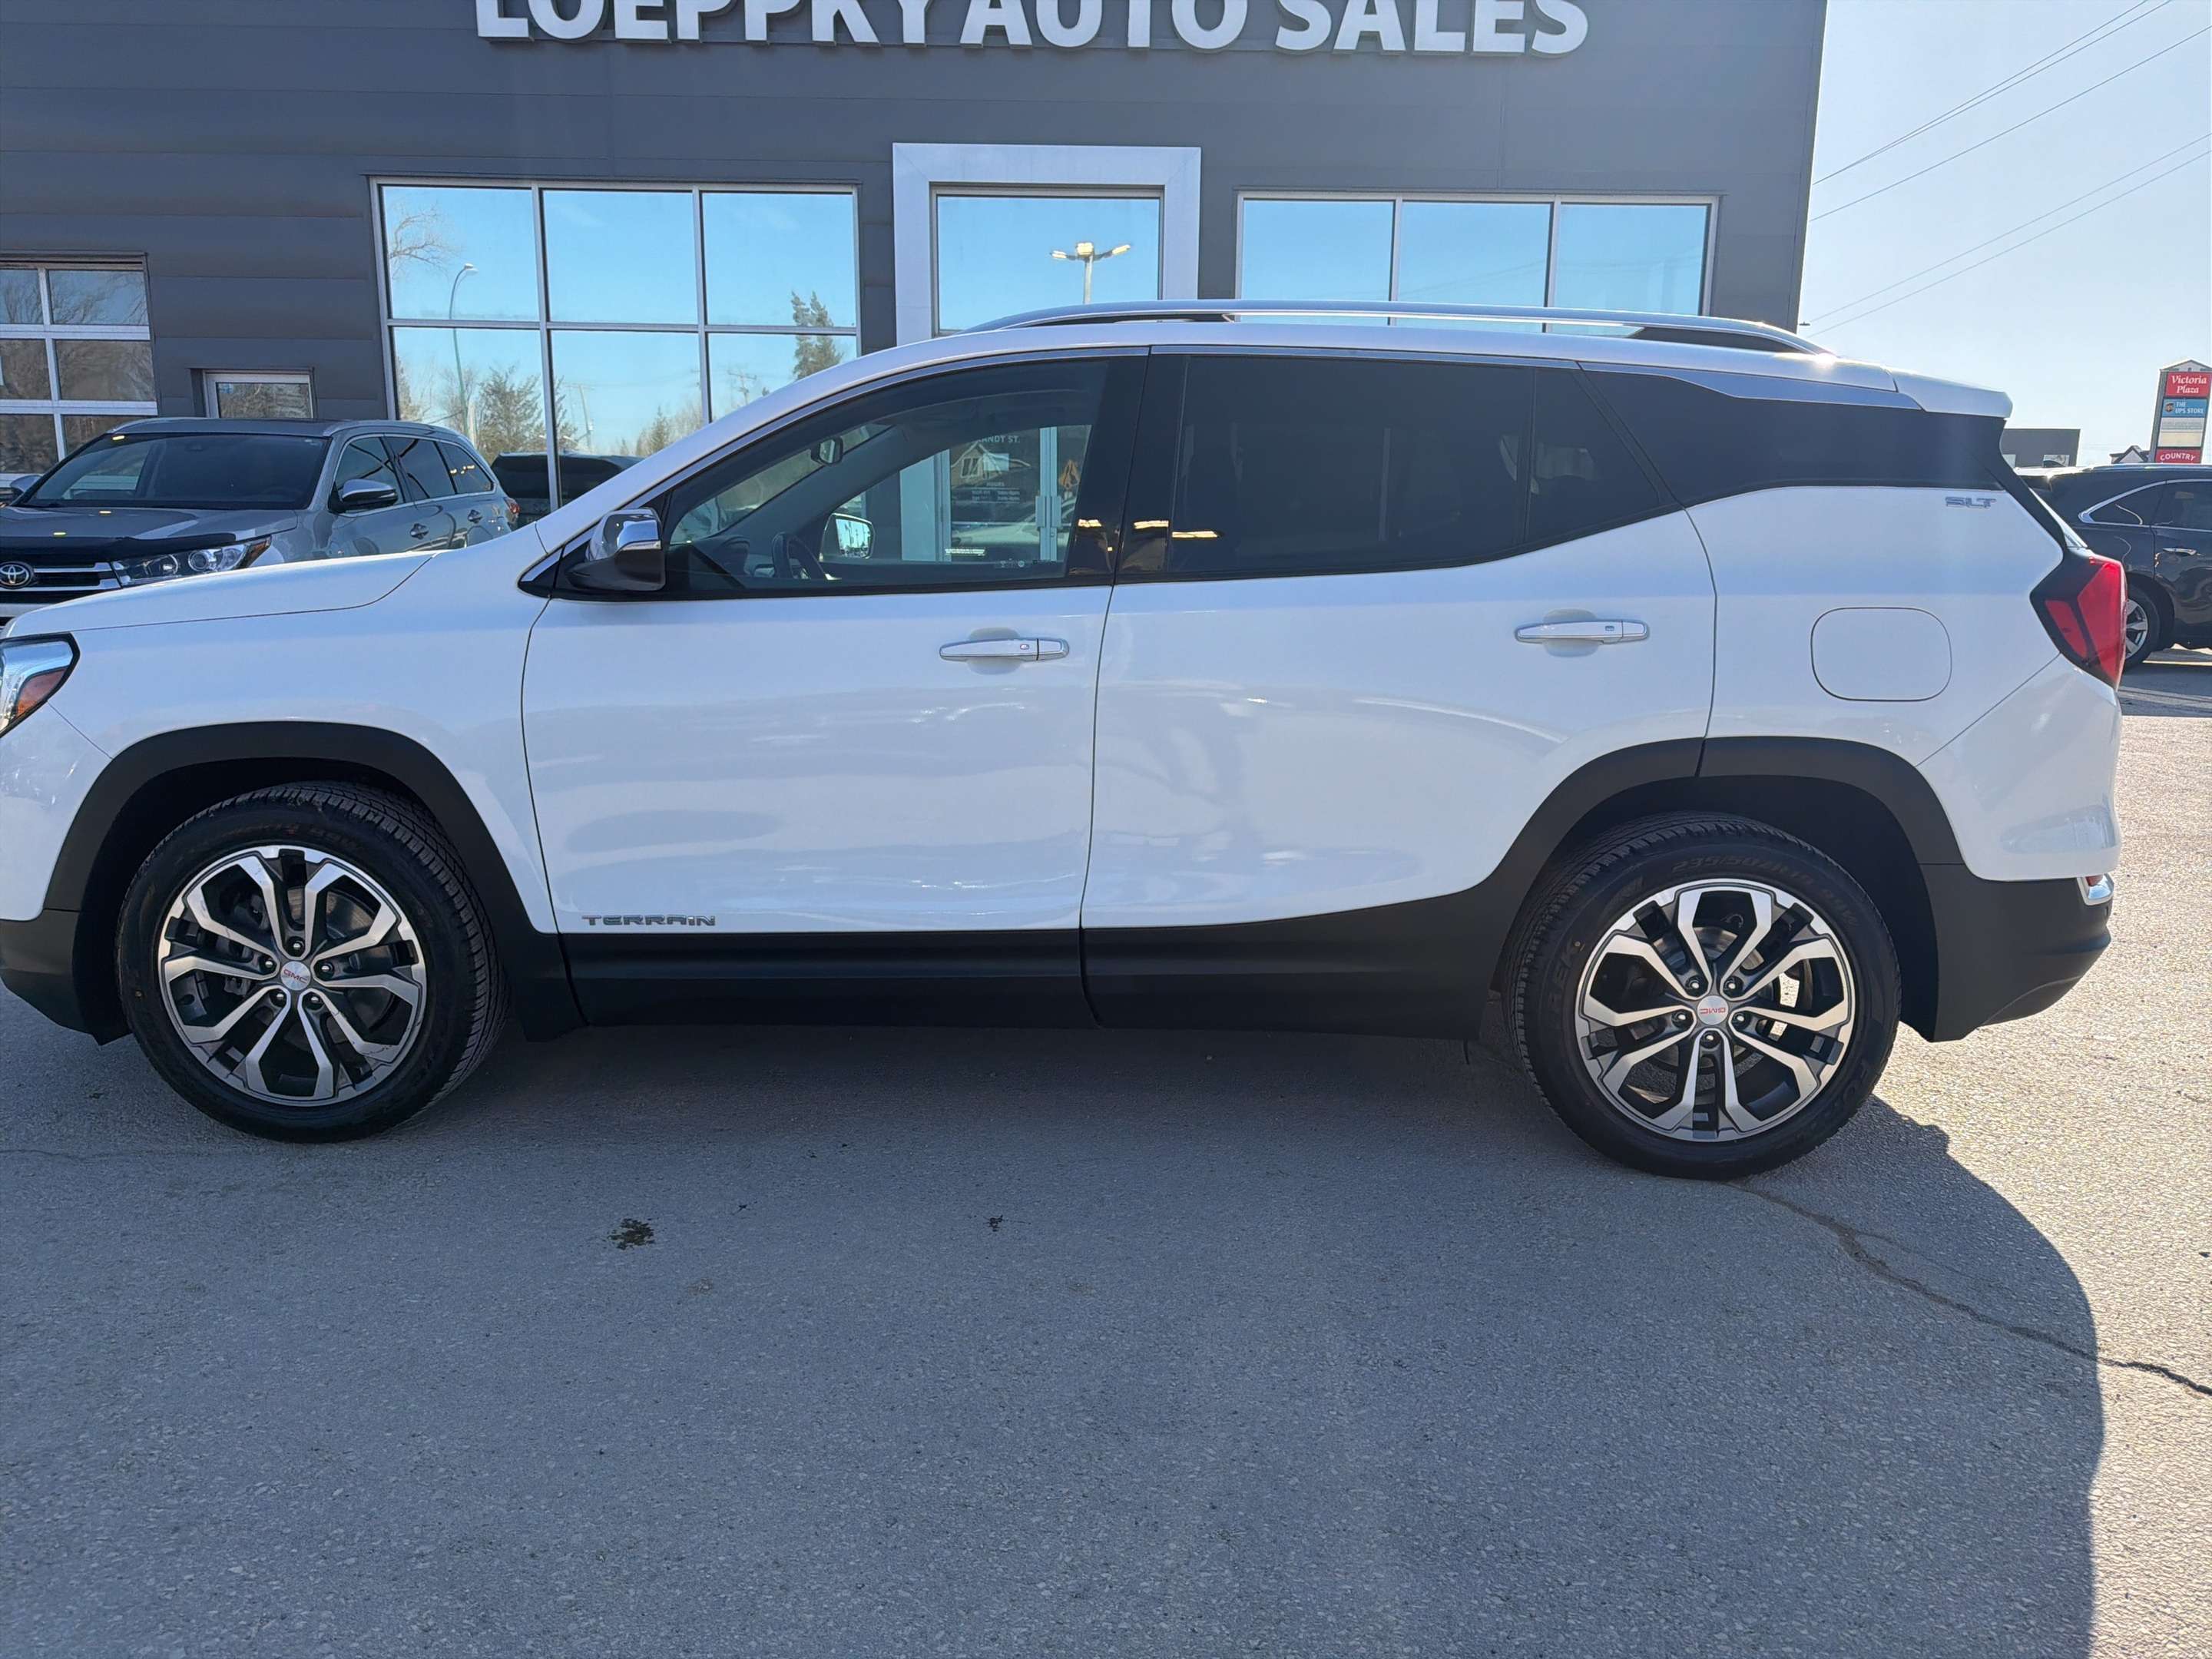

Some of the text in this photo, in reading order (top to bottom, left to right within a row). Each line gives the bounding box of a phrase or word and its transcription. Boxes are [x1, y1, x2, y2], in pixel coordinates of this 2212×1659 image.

[1275, 0, 1588, 55] SALES
[2171, 376, 2207, 384] Victoria
[2160, 452, 2196, 462] COUNTRY
[1945, 496, 1997, 508] SLT
[581, 914, 716, 926] TERRAIN
[283, 969, 308, 984] GMC
